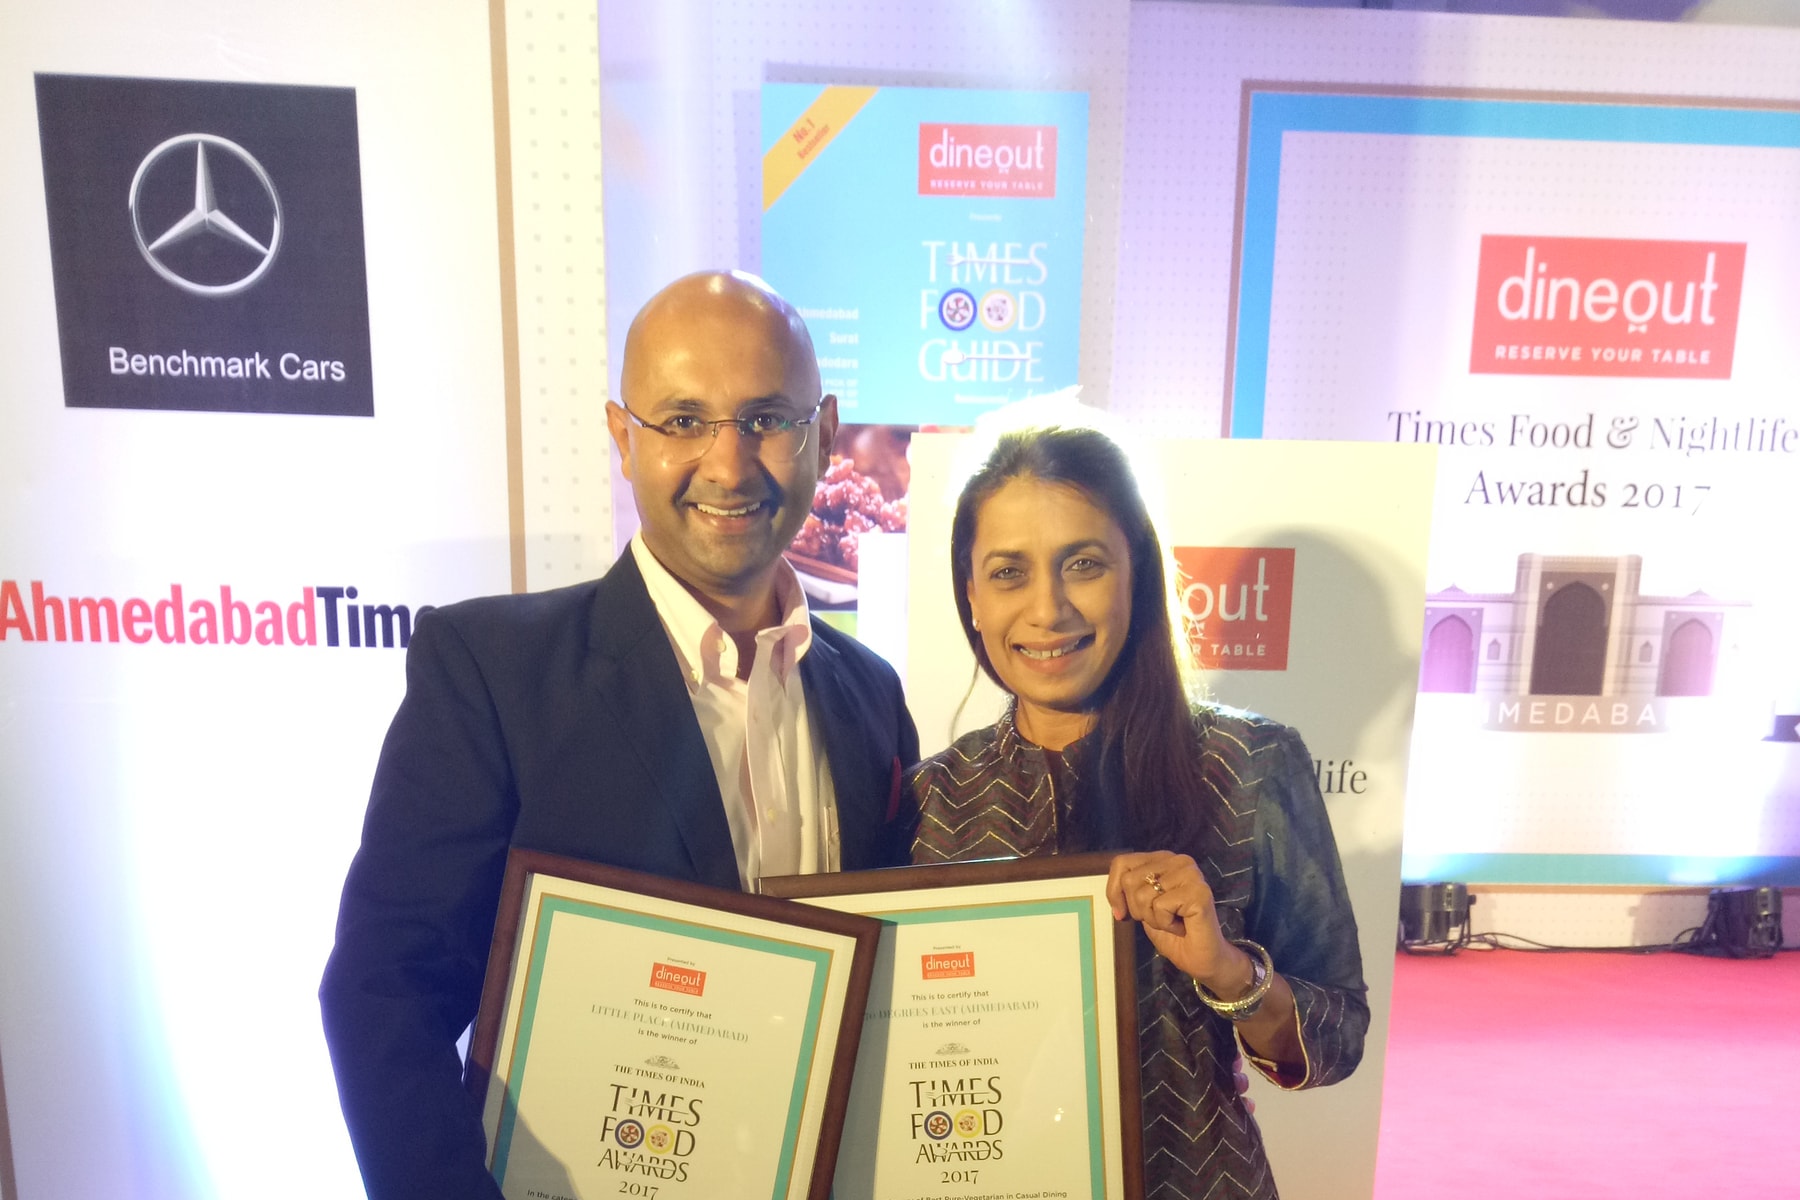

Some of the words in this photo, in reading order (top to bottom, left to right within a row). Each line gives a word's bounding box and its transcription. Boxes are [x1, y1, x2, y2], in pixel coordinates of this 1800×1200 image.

[929, 128, 1044, 171] dineout
[921, 241, 1048, 285] TIMES
[1497, 246, 1718, 326] dineout
[920, 287, 1046, 333] FOOD
[109, 346, 272, 379] Benchmark
[279, 352, 346, 382] Cars
[918, 339, 1045, 382] GUIDE
[1495, 345, 1582, 361] RESERVE
[1591, 347, 1643, 363] YOUR
[1651, 348, 1711, 365] TABLE
[1387, 410, 1495, 447] Times
[1509, 413, 1595, 449] Food
[1607, 416, 1639, 449] &
[1650, 416, 1799, 457] Nightlife
[1463, 469, 1607, 508] Awards
[1621, 483, 1711, 516] 2017
[1181, 557, 1270, 621] out
[1211, 643, 1266, 656] TABLE
[1486, 701, 1658, 726] MEDABA
[1314, 759, 1368, 794] life
[925, 954, 971, 971] dineout
[655, 966, 701, 987] dineout
[947, 991, 971, 1000] certify
[973, 990, 989, 998] that
[591, 1004, 629, 1020] LITTLE
[633, 998, 649, 1008] This
[659, 1003, 668, 1011] to
[670, 1006, 694, 1018] certify
[696, 1010, 712, 1020] that
[878, 1007, 928, 1020] DEGREES
[931, 1005, 959, 1018] EAST
[922, 1021, 929, 1029] is
[931, 1020, 943, 1028] the
[945, 1019, 970, 1027] winner
[973, 1018, 981, 1026] of
[638, 1027, 645, 1036] is
[646, 1029, 659, 1038] the
[661, 1033, 686, 1044] winner
[689, 1038, 698, 1046] of
[908, 1062, 927, 1070] THE
[928, 1060, 957, 1069] TIMES
[958, 1059, 972, 1068] OF
[973, 1057, 999, 1066] INDIA
[613, 1064, 633, 1075] THE
[635, 1068, 663, 1081] TIMES
[665, 1074, 679, 1083] OF
[680, 1077, 705, 1089] INDIA
[909, 1076, 1002, 1108] TIMES
[610, 1083, 703, 1127] TIMES
[600, 1115, 696, 1157] FOOD
[911, 1108, 1003, 1140] FOOD
[915, 1140, 1003, 1164] AWARDS
[597, 1148, 690, 1182] AWARDS
[941, 1170, 979, 1184] 2017
[527, 1189, 535, 1197] In
[537, 1191, 549, 1200] the
[619, 1180, 659, 1200] 2017
[1042, 1191, 1067, 1199] Dining
